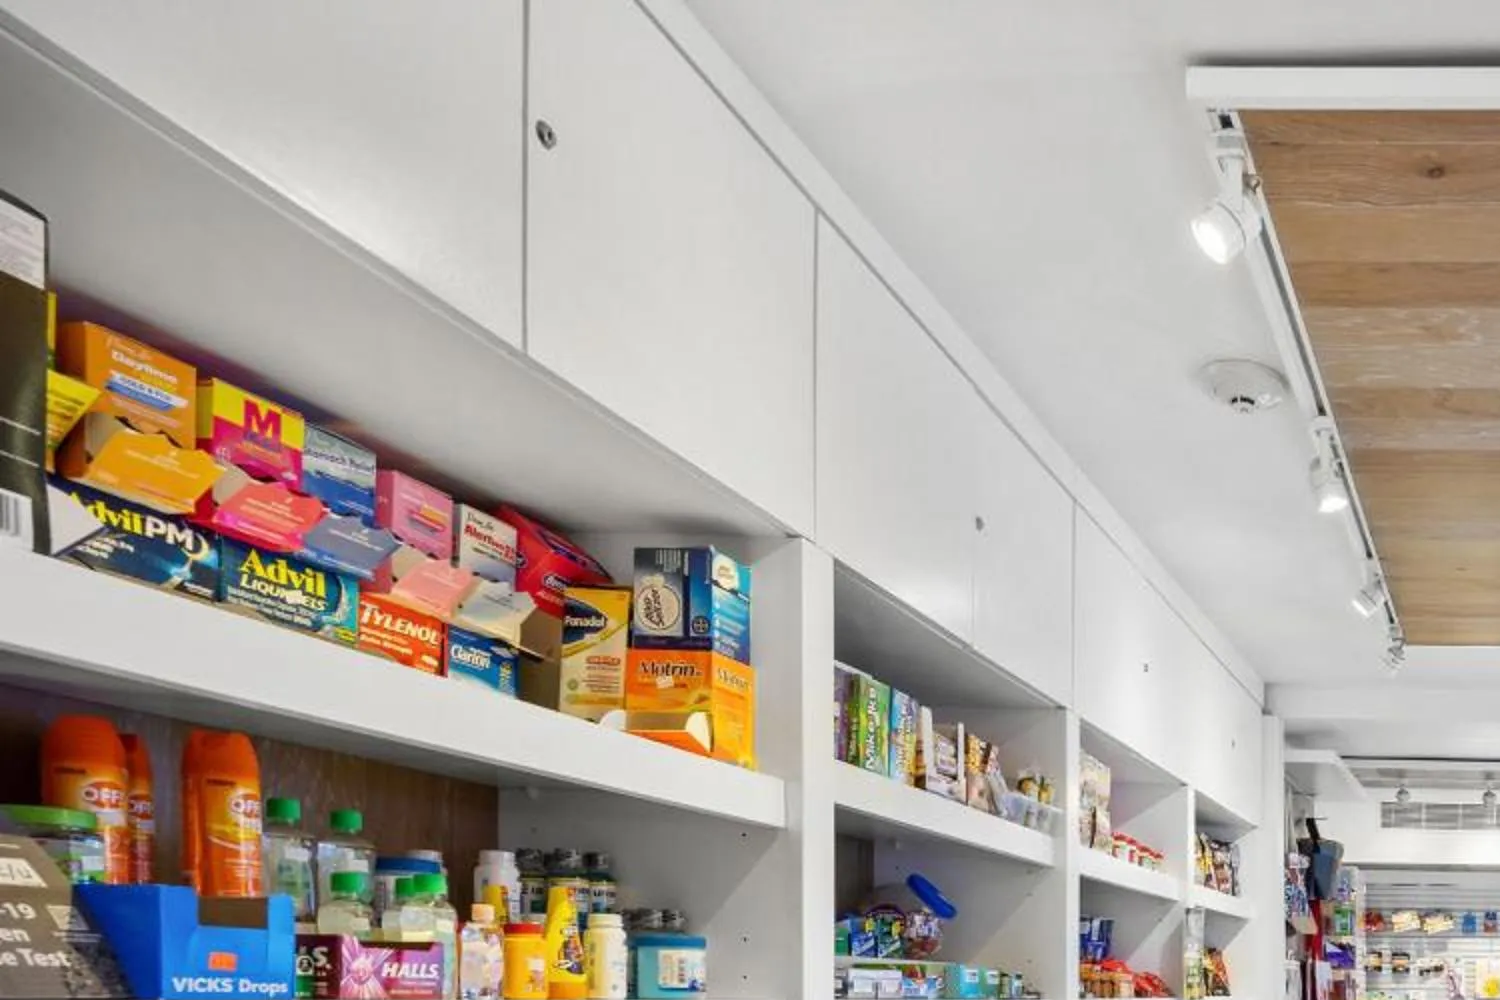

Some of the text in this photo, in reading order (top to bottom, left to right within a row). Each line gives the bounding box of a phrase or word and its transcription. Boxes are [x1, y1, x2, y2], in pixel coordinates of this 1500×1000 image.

[144, 515, 194, 551] PM
[239, 548, 326, 598] Advil
[360, 601, 441, 645] TYLENOL
[563, 614, 606, 628] Panadol
[451, 643, 491, 668] Claritin
[640, 660, 697, 677] Motrin
[16, 948, 72, 967] Test
[381, 962, 440, 979] HALLS
[172, 977, 289, 998] VICKS Drops
